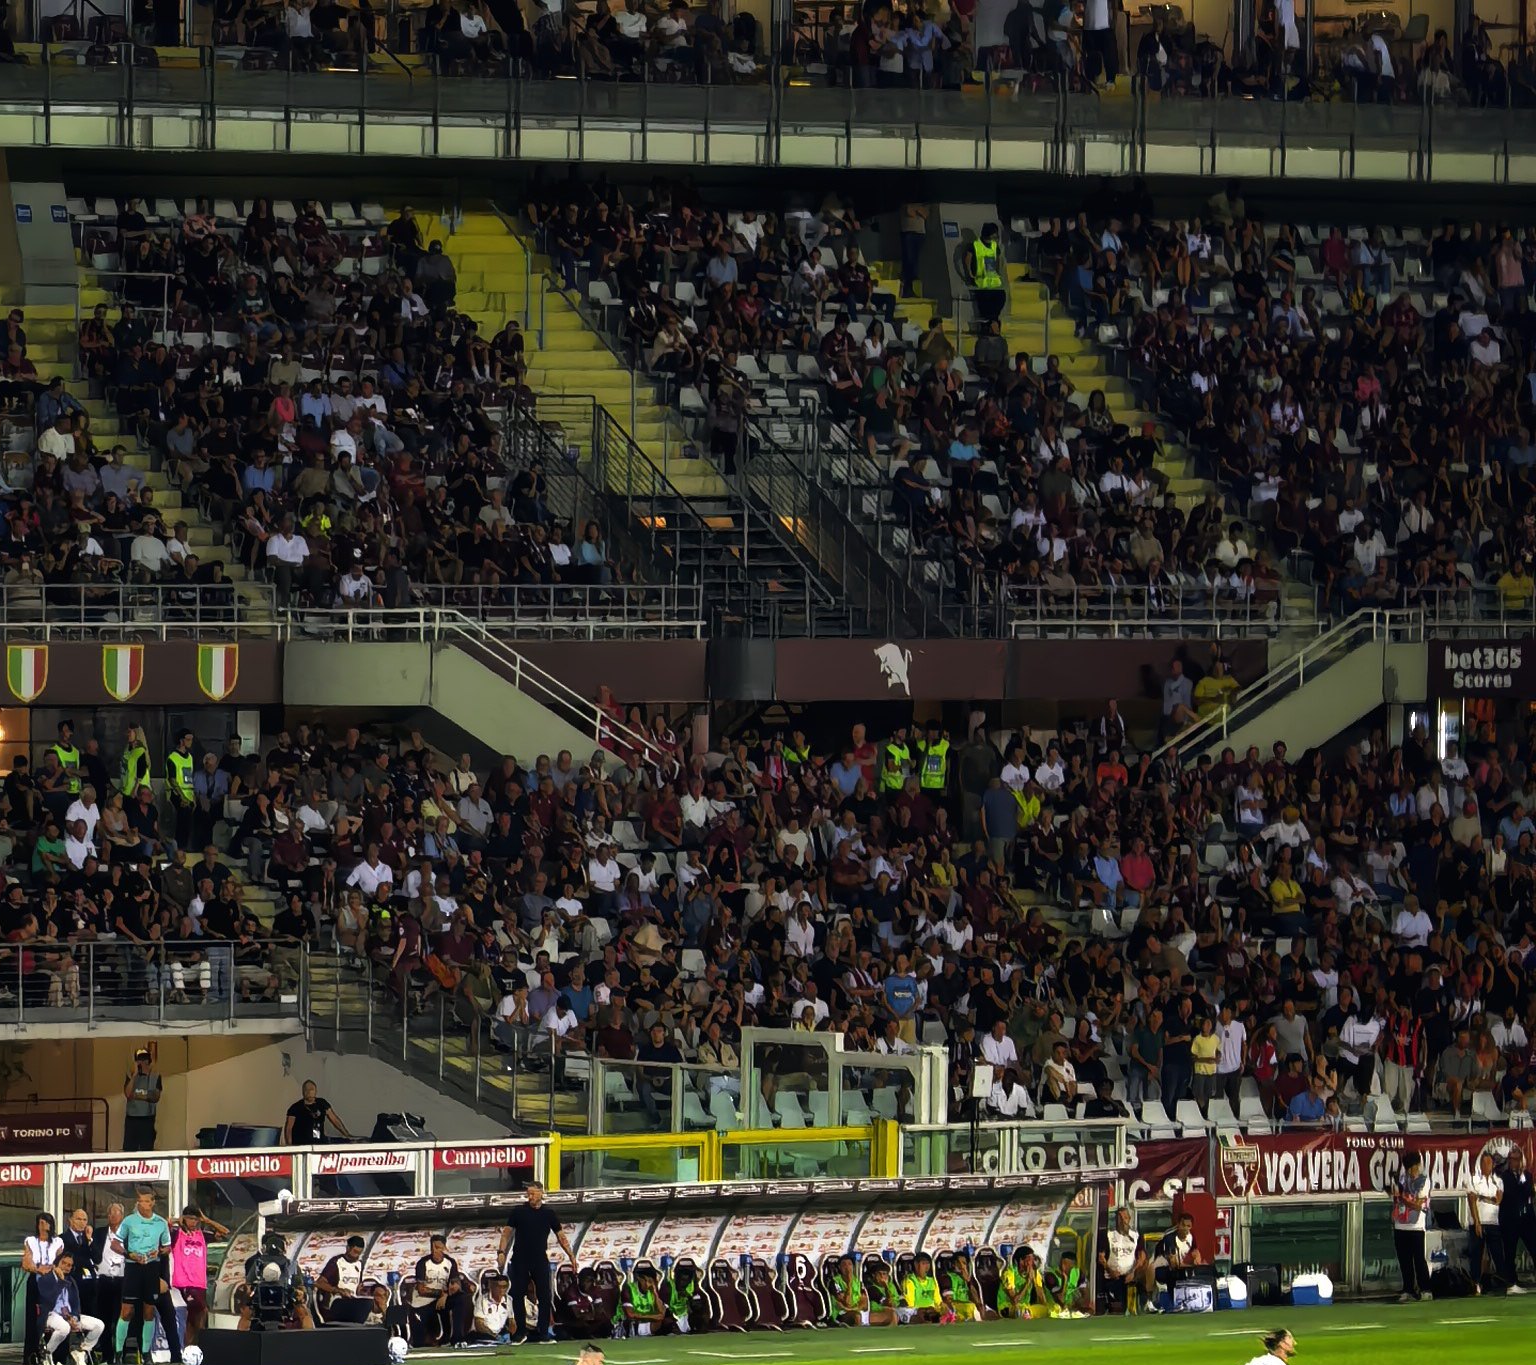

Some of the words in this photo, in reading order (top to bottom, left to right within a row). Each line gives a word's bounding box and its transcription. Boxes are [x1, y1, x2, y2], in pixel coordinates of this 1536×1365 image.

[1445, 645, 1522, 669] bet365
[13, 1129, 54, 1138] TORINO
[56, 1128, 71, 1136] FC
[196, 1156, 281, 1178] Campiello
[441, 1147, 527, 1168] Campiello
[1058, 1145, 1139, 1173] CLUB
[1264, 1150, 1362, 1192] VOLVERA
[1369, 1149, 1475, 1192] GRATA
